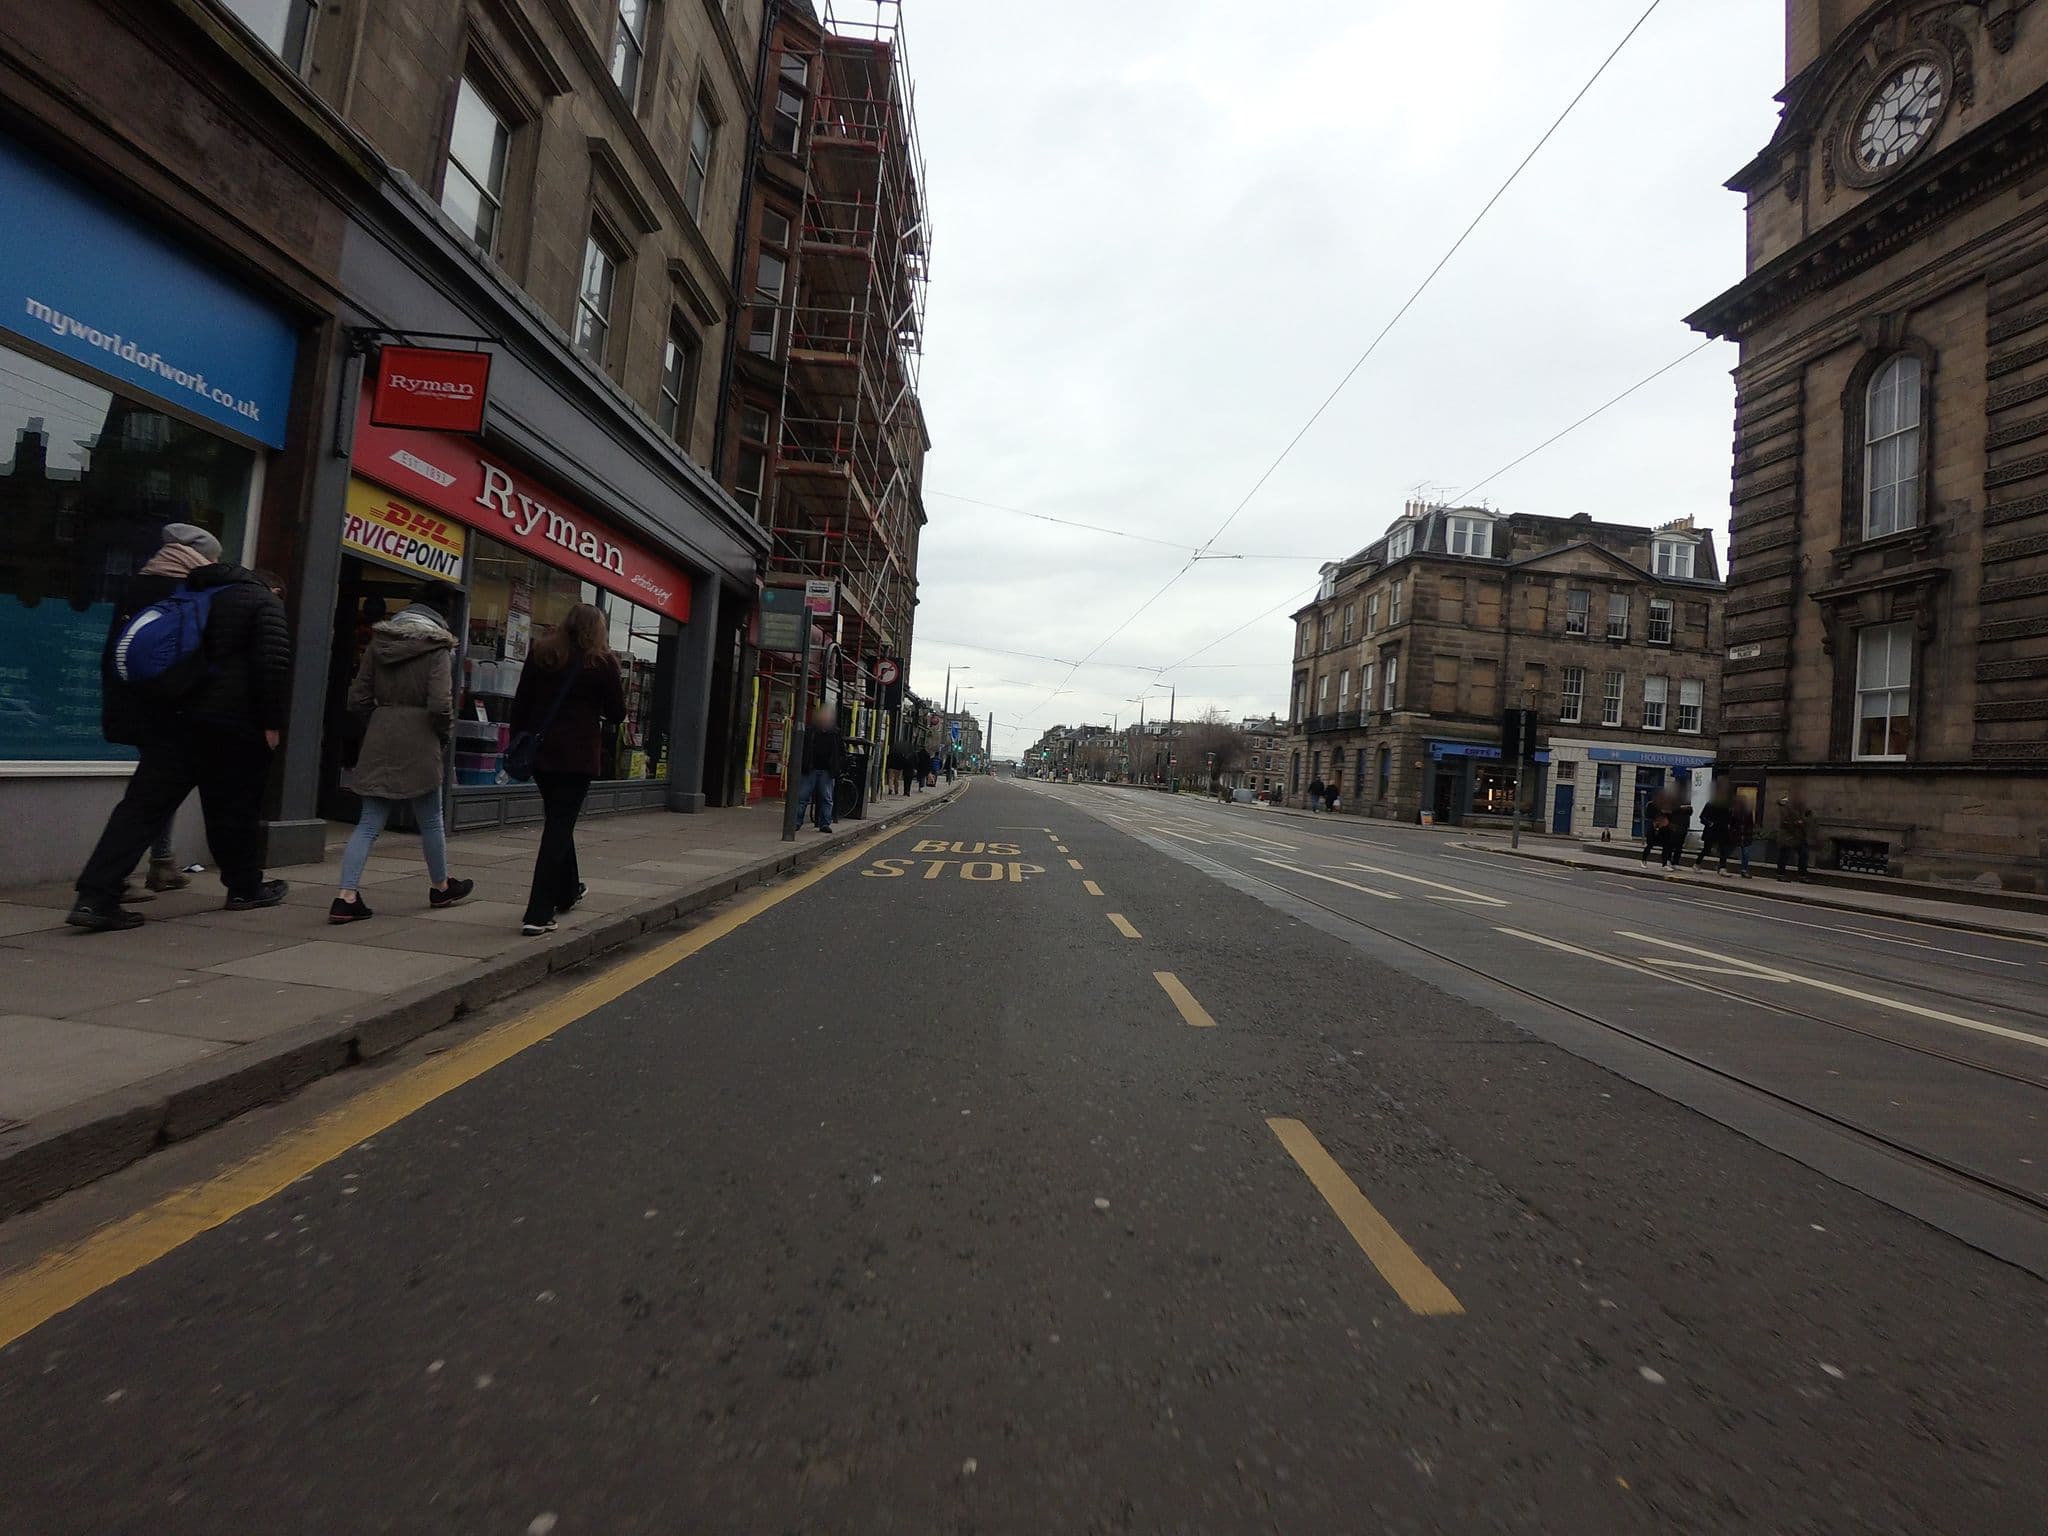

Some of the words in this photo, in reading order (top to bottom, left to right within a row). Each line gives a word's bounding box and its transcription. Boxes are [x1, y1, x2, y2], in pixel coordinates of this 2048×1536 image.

[25, 296, 261, 422] myworldofwork.co.uk
[388, 373, 475, 396] Ryman
[383, 501, 454, 546] DHL
[475, 459, 625, 576] Ryman
[911, 839, 1022, 855] BUS
[861, 859, 1046, 882] STOP
